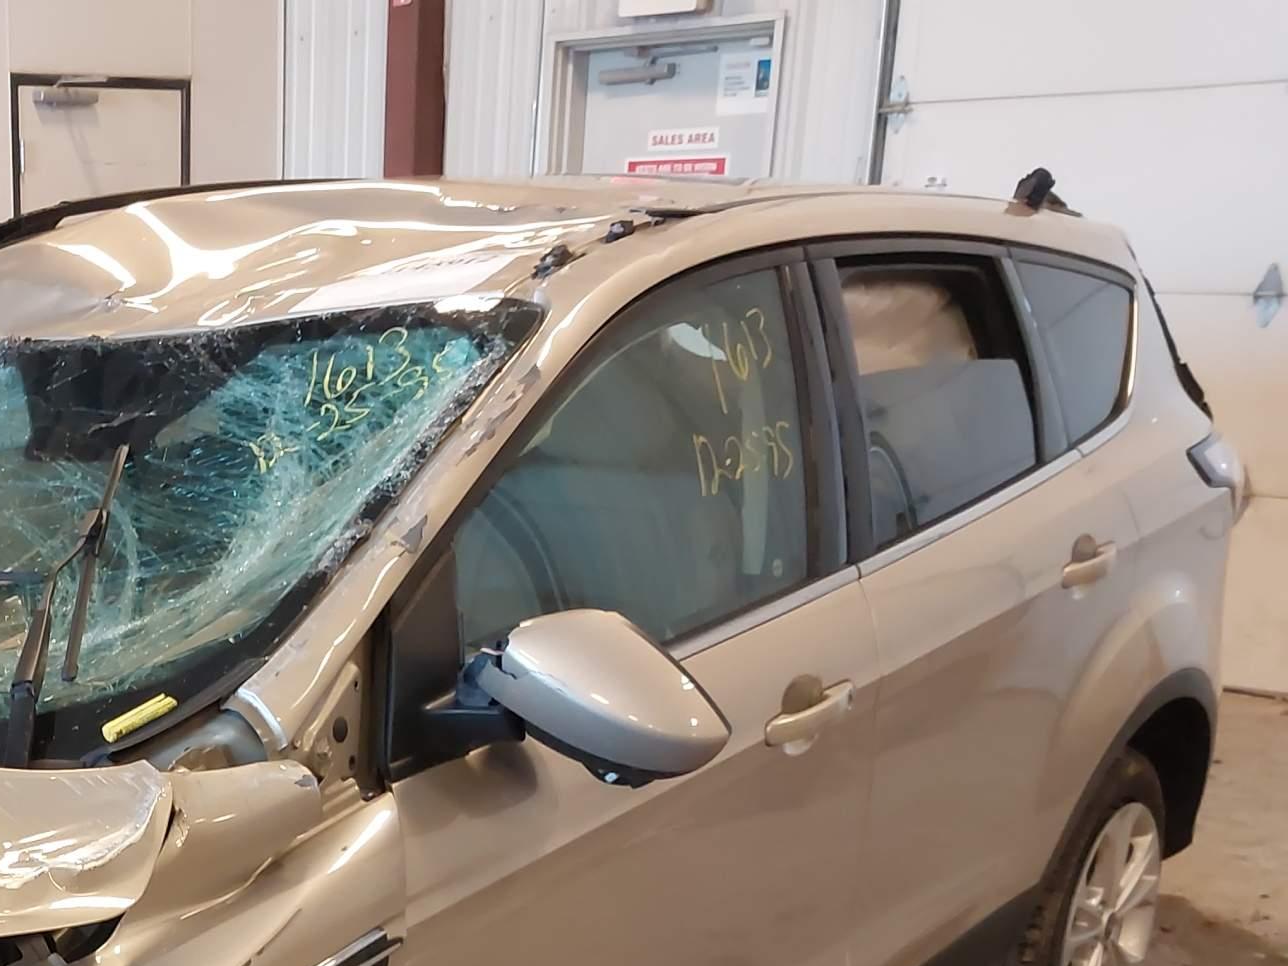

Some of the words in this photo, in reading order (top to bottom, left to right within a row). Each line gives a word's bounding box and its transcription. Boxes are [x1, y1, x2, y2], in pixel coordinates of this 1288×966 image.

[651, 133, 684, 146] SALES
[687, 132, 716, 145] AREA
[303, 325, 410, 409] 1613
